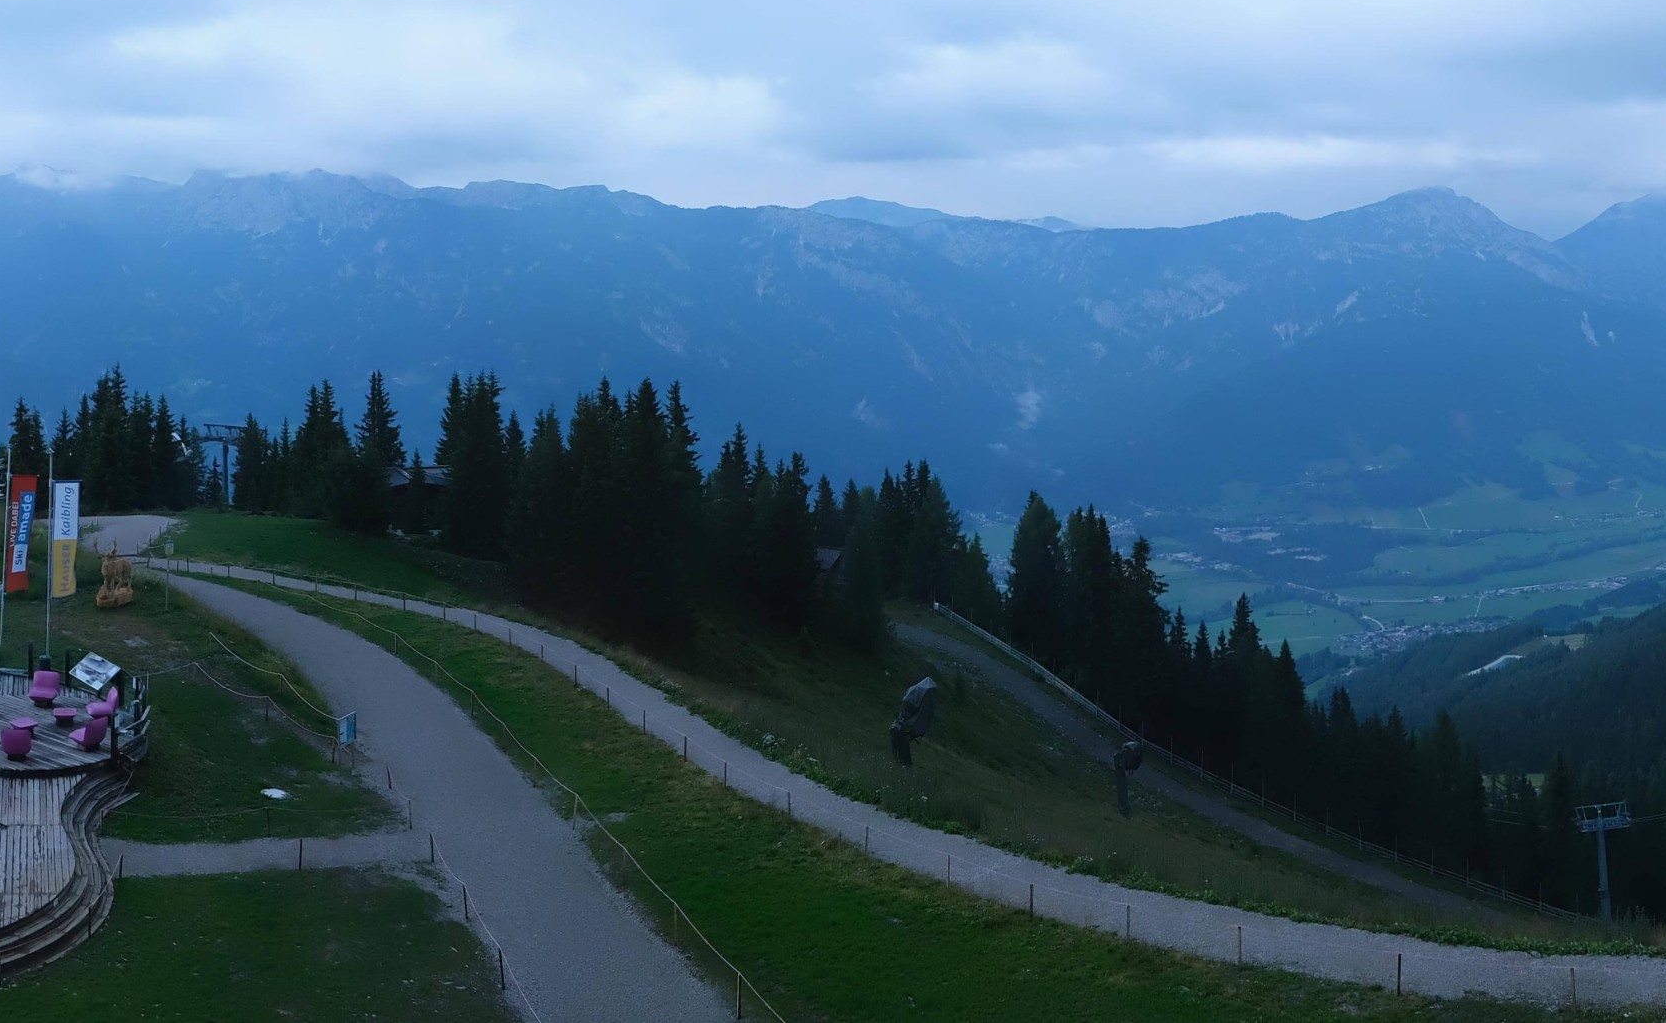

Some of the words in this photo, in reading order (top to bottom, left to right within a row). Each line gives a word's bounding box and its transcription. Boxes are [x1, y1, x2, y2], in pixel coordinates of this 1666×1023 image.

[61, 486, 74, 537] Kaibling
[15, 550, 23, 566] Ski
[61, 544, 71, 592] HAUSER
